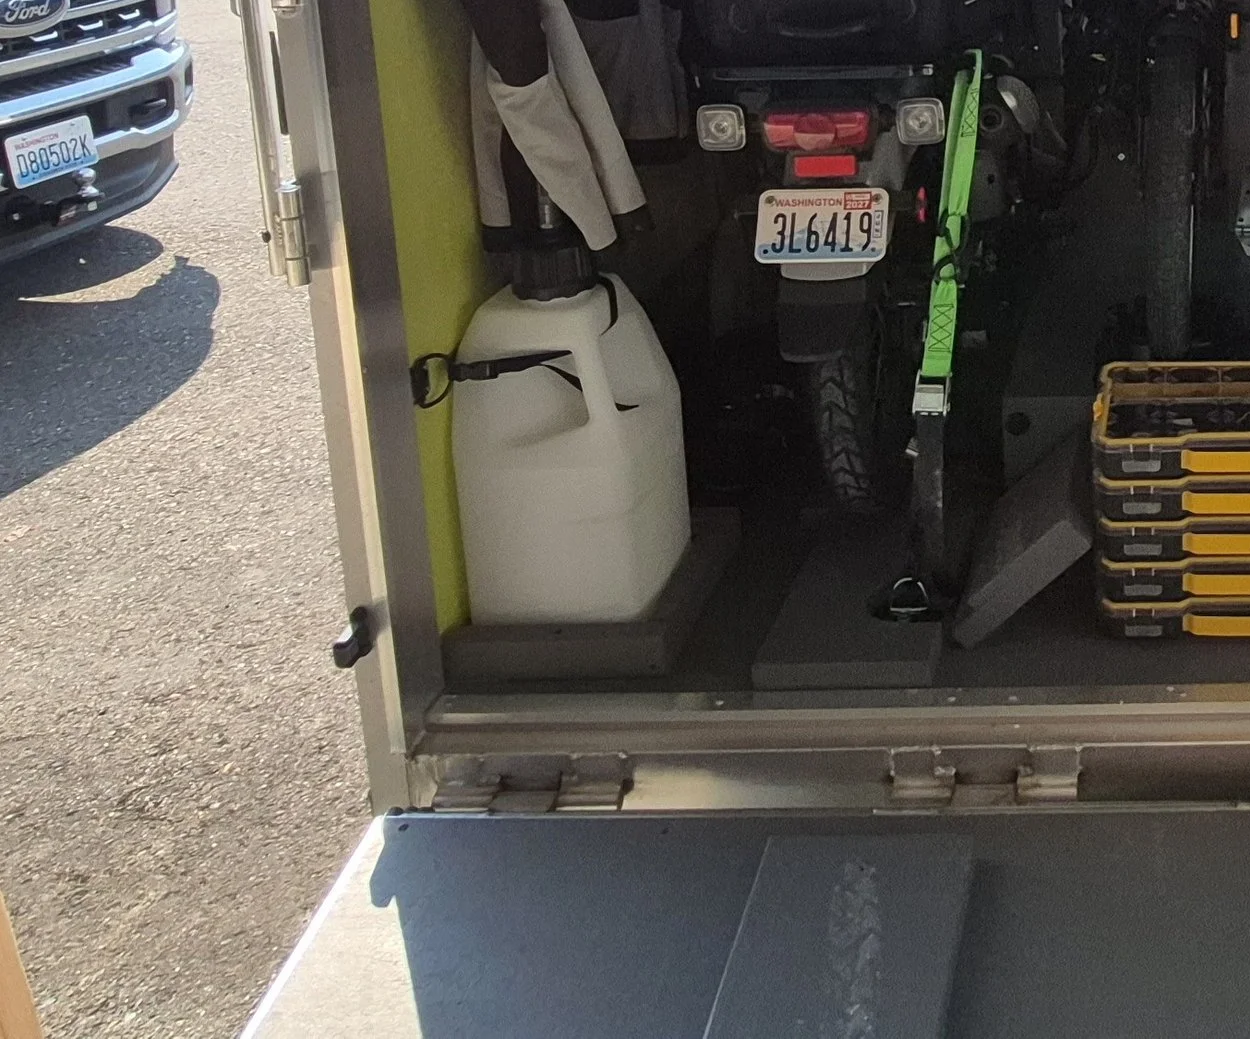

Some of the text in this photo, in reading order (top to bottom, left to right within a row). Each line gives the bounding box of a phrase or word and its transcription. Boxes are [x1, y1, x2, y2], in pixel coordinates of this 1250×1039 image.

[16, 133, 91, 178] D80502K
[774, 198, 842, 207] WASHINGTON
[846, 201, 869, 209] 2027
[771, 212, 872, 253] 3L6419
